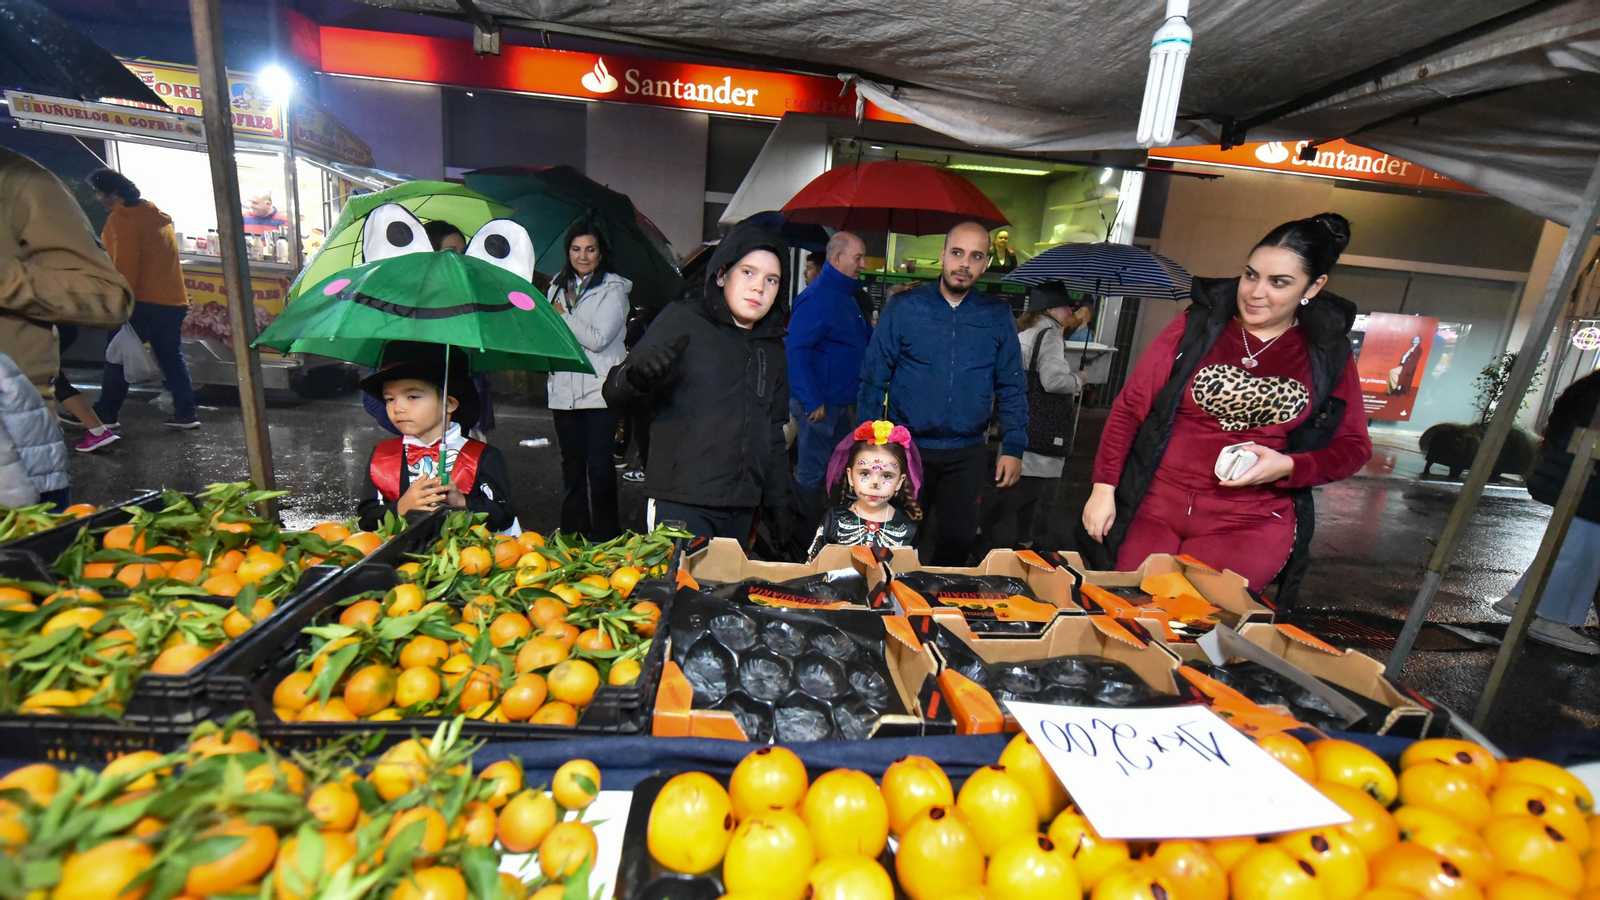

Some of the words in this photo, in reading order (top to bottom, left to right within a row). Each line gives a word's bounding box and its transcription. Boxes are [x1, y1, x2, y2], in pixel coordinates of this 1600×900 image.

[624, 68, 759, 107] Santander
[784, 98, 855, 115] EMPRESAS
[32, 102, 110, 123] BUÑUELOS
[114, 114, 124, 125] &
[128, 116, 183, 133] GOFRES
[749, 586, 834, 606] LEGENDARIA
[930, 591, 1010, 600] LEGENDARIA
